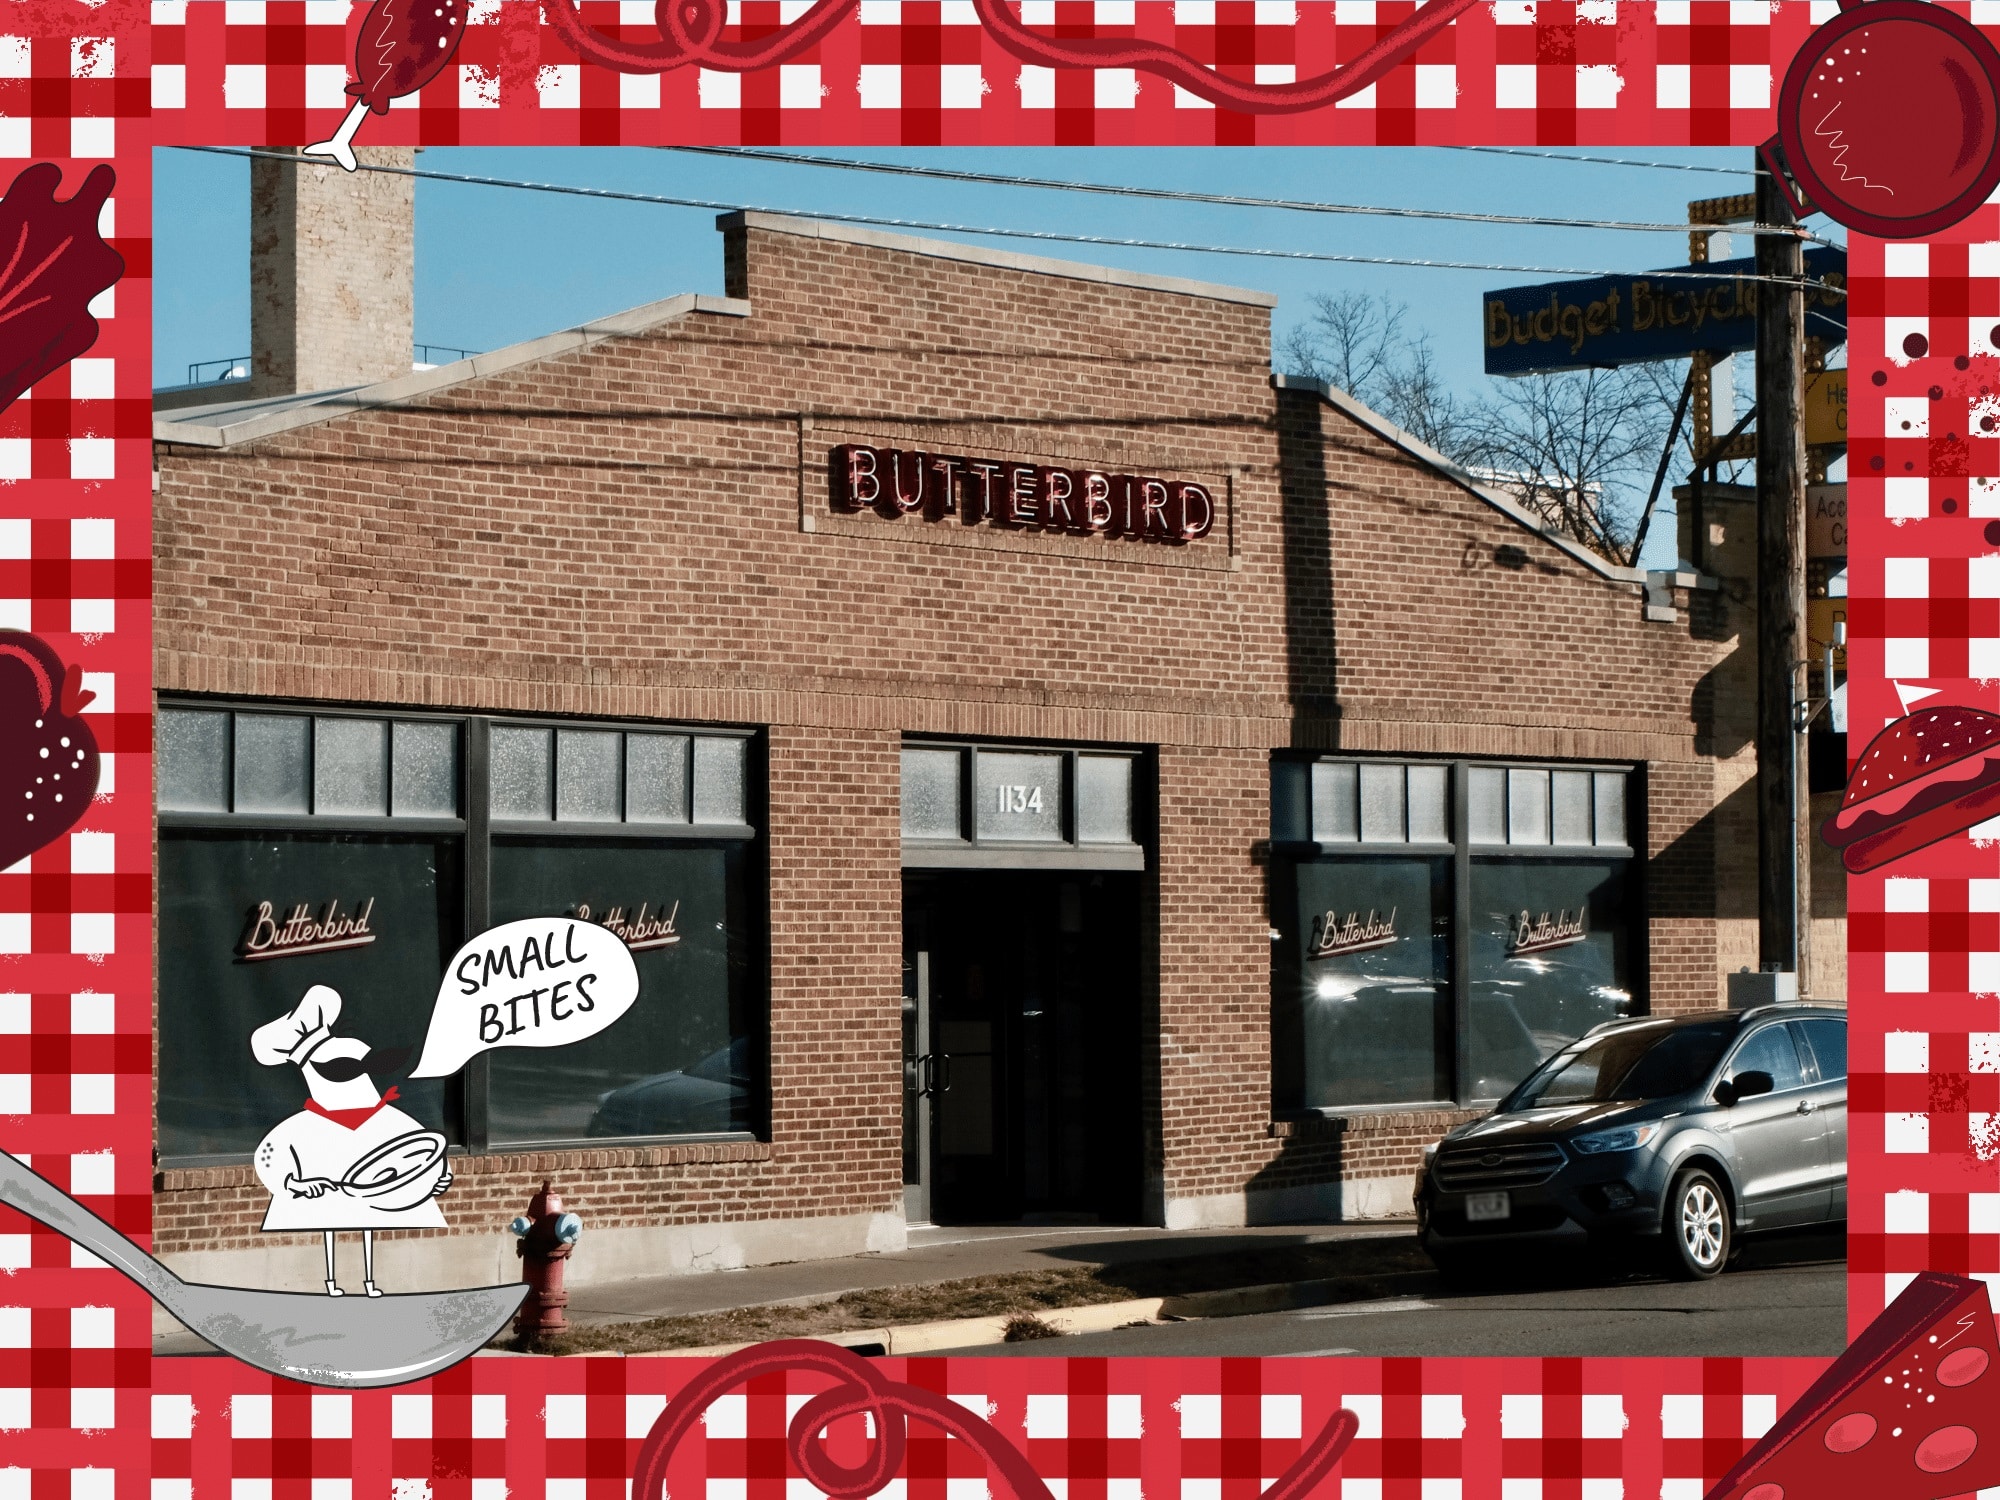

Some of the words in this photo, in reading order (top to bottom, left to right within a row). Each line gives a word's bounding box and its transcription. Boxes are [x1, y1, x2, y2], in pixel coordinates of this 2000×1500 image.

[1488, 286, 1621, 356] Budget
[840, 444, 1215, 540] BUTTERBIRD
[999, 784, 1044, 814] 1134
[248, 896, 375, 950] Butterbird
[578, 899, 680, 940] tterbird
[1319, 906, 1397, 948] Butterbird
[1514, 906, 1585, 947] Butterbird
